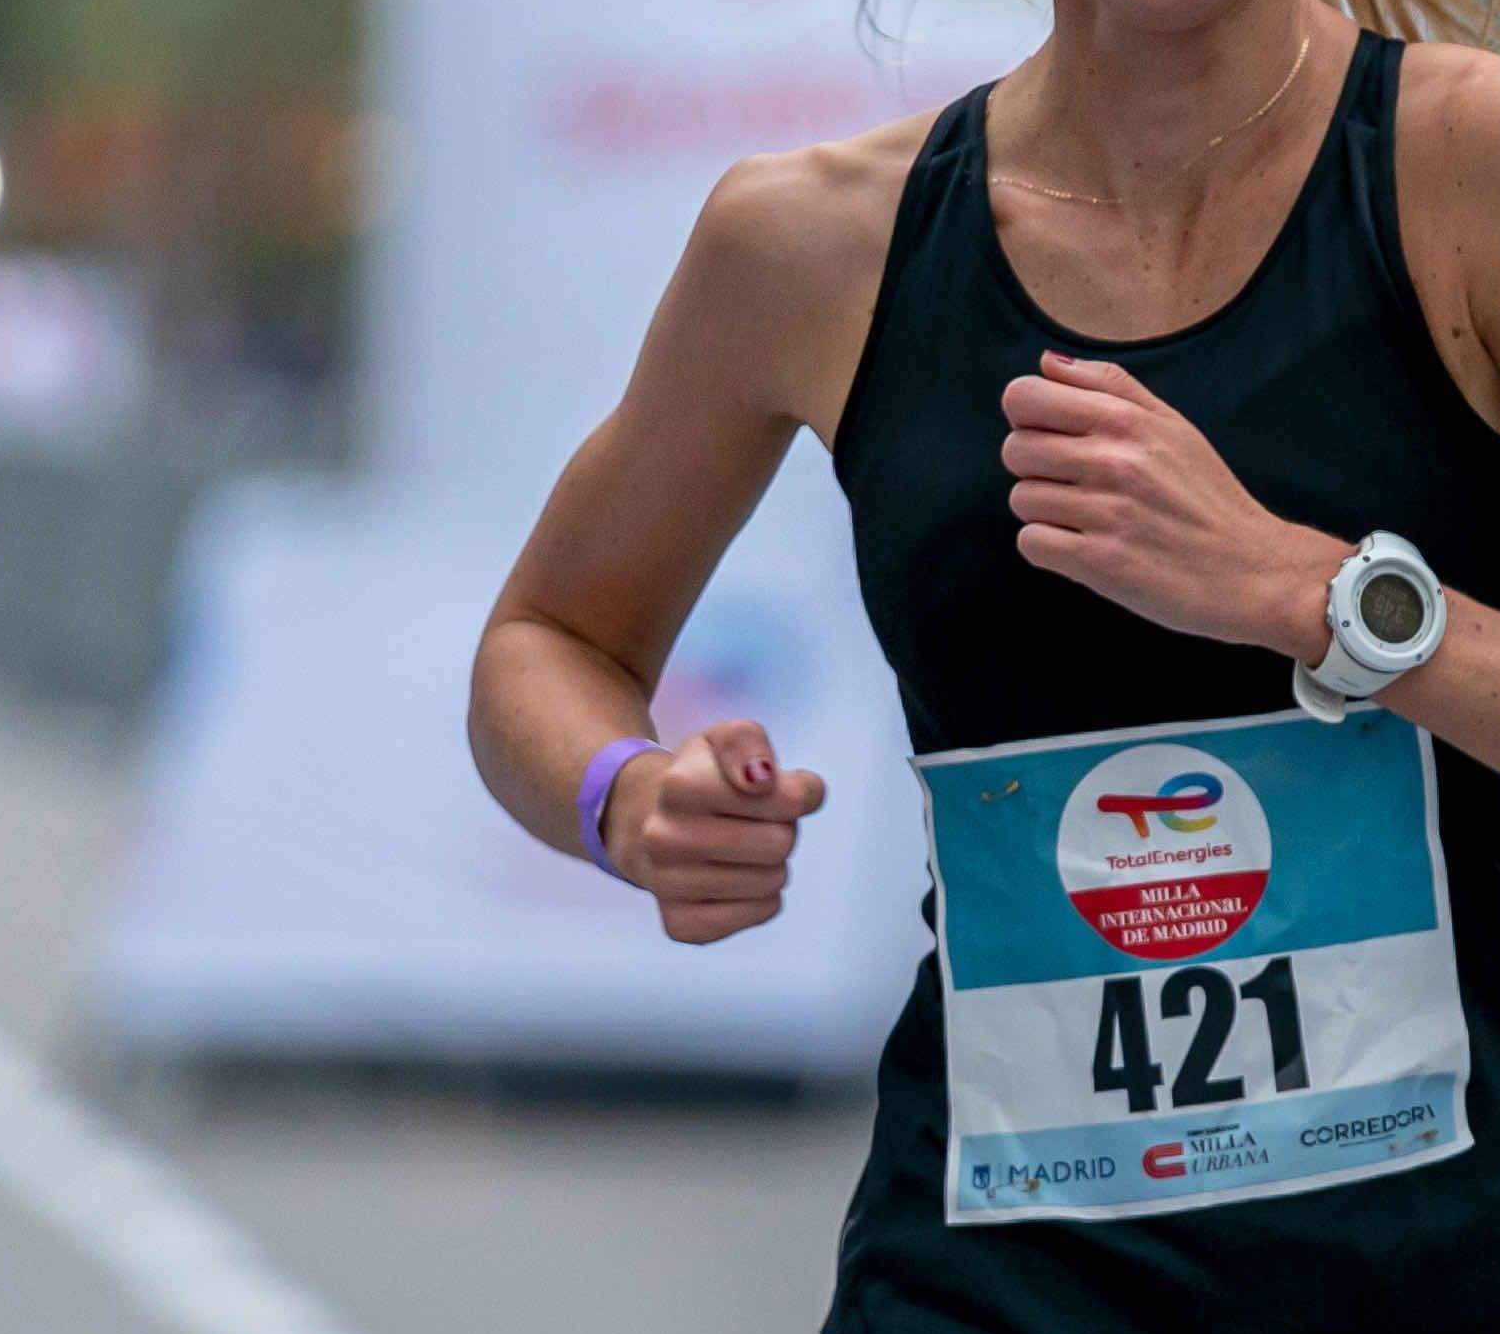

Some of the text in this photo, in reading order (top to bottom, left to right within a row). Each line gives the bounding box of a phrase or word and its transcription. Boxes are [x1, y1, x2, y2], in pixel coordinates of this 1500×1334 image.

[1106, 842, 1233, 871] TotalEnergies
[1140, 882, 1201, 904] MILLA
[1122, 917, 1228, 947] DE MADRID
[1093, 956, 1310, 1114] 421
[1190, 1131, 1257, 1153] MILLA
[1008, 1156, 1116, 1185] MADRID
[1192, 1147, 1270, 1174] URBANA
